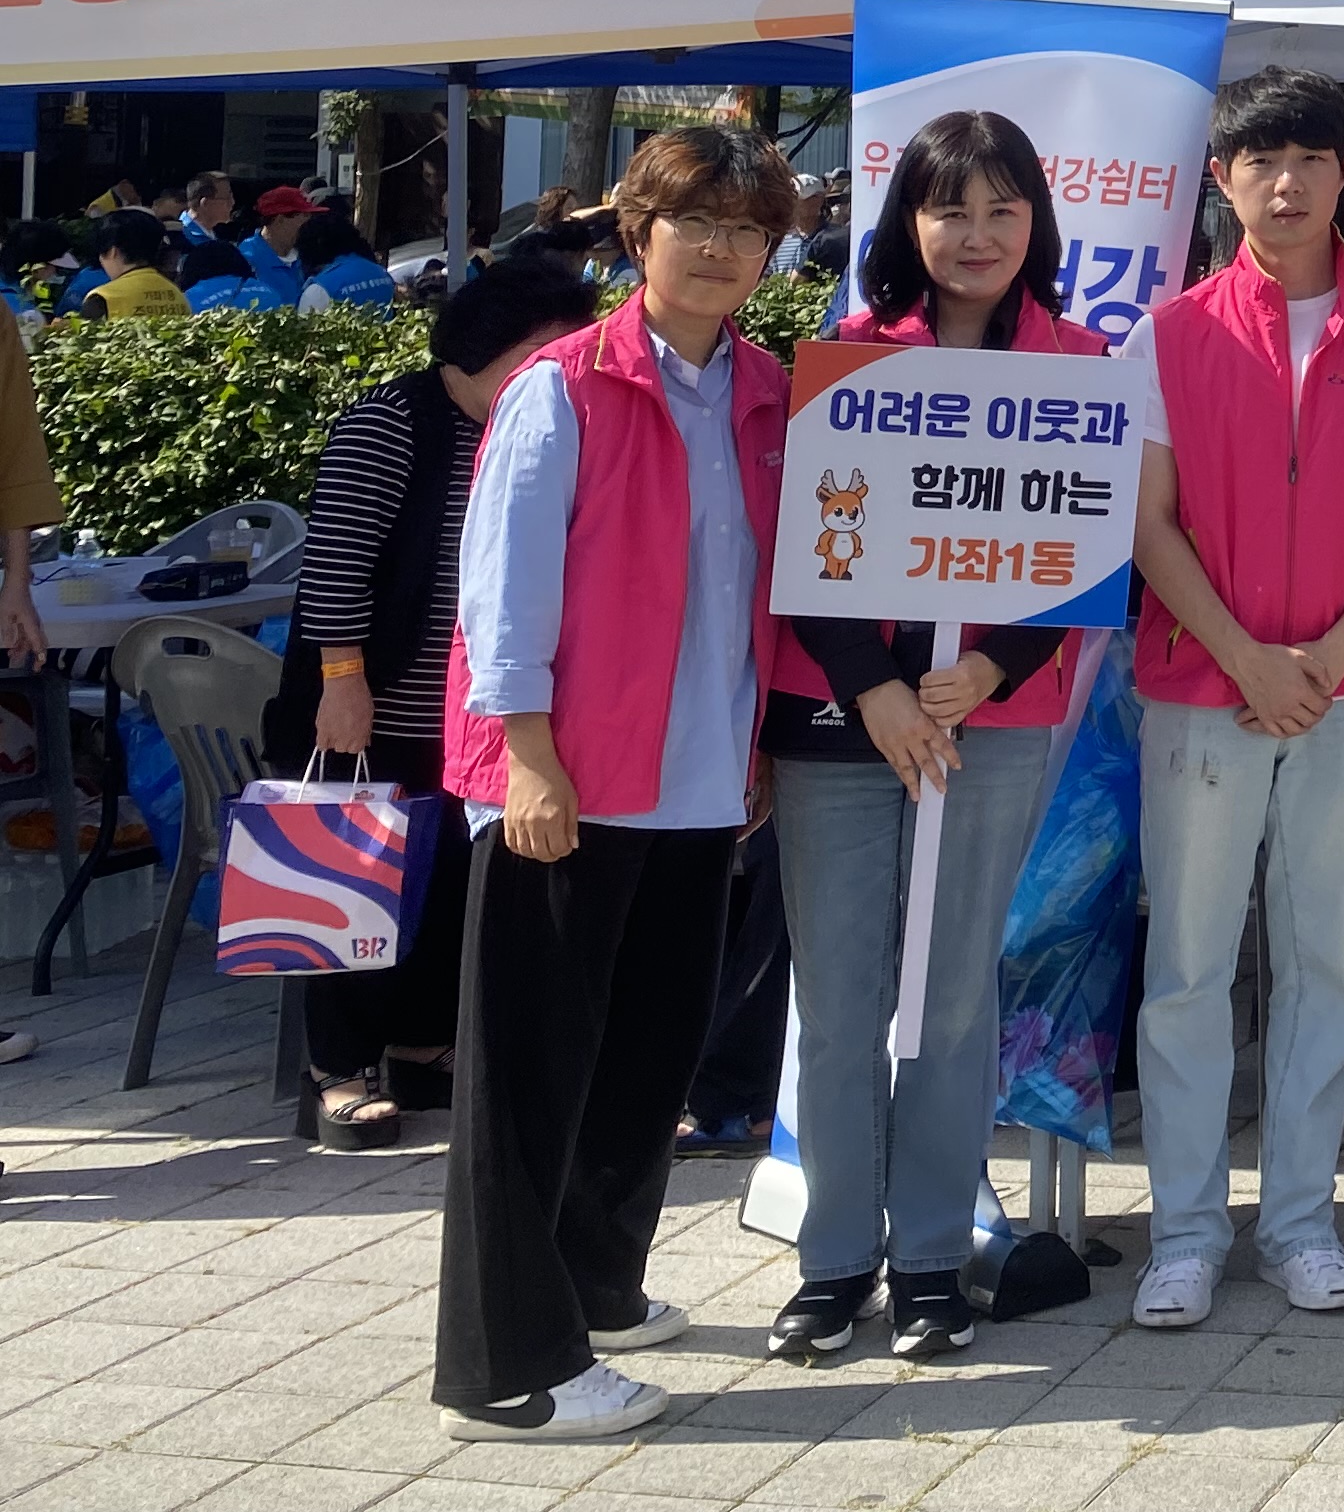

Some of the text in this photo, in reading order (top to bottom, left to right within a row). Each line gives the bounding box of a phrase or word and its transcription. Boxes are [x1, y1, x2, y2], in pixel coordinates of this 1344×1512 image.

[829, 388, 1129, 446] 어려운 이웃과
[911, 463, 1114, 516] 함께 하는
[906, 536, 1076, 587] 가좌1동
[811, 718, 846, 727] KANGOL
[352, 937, 388, 959] BR
